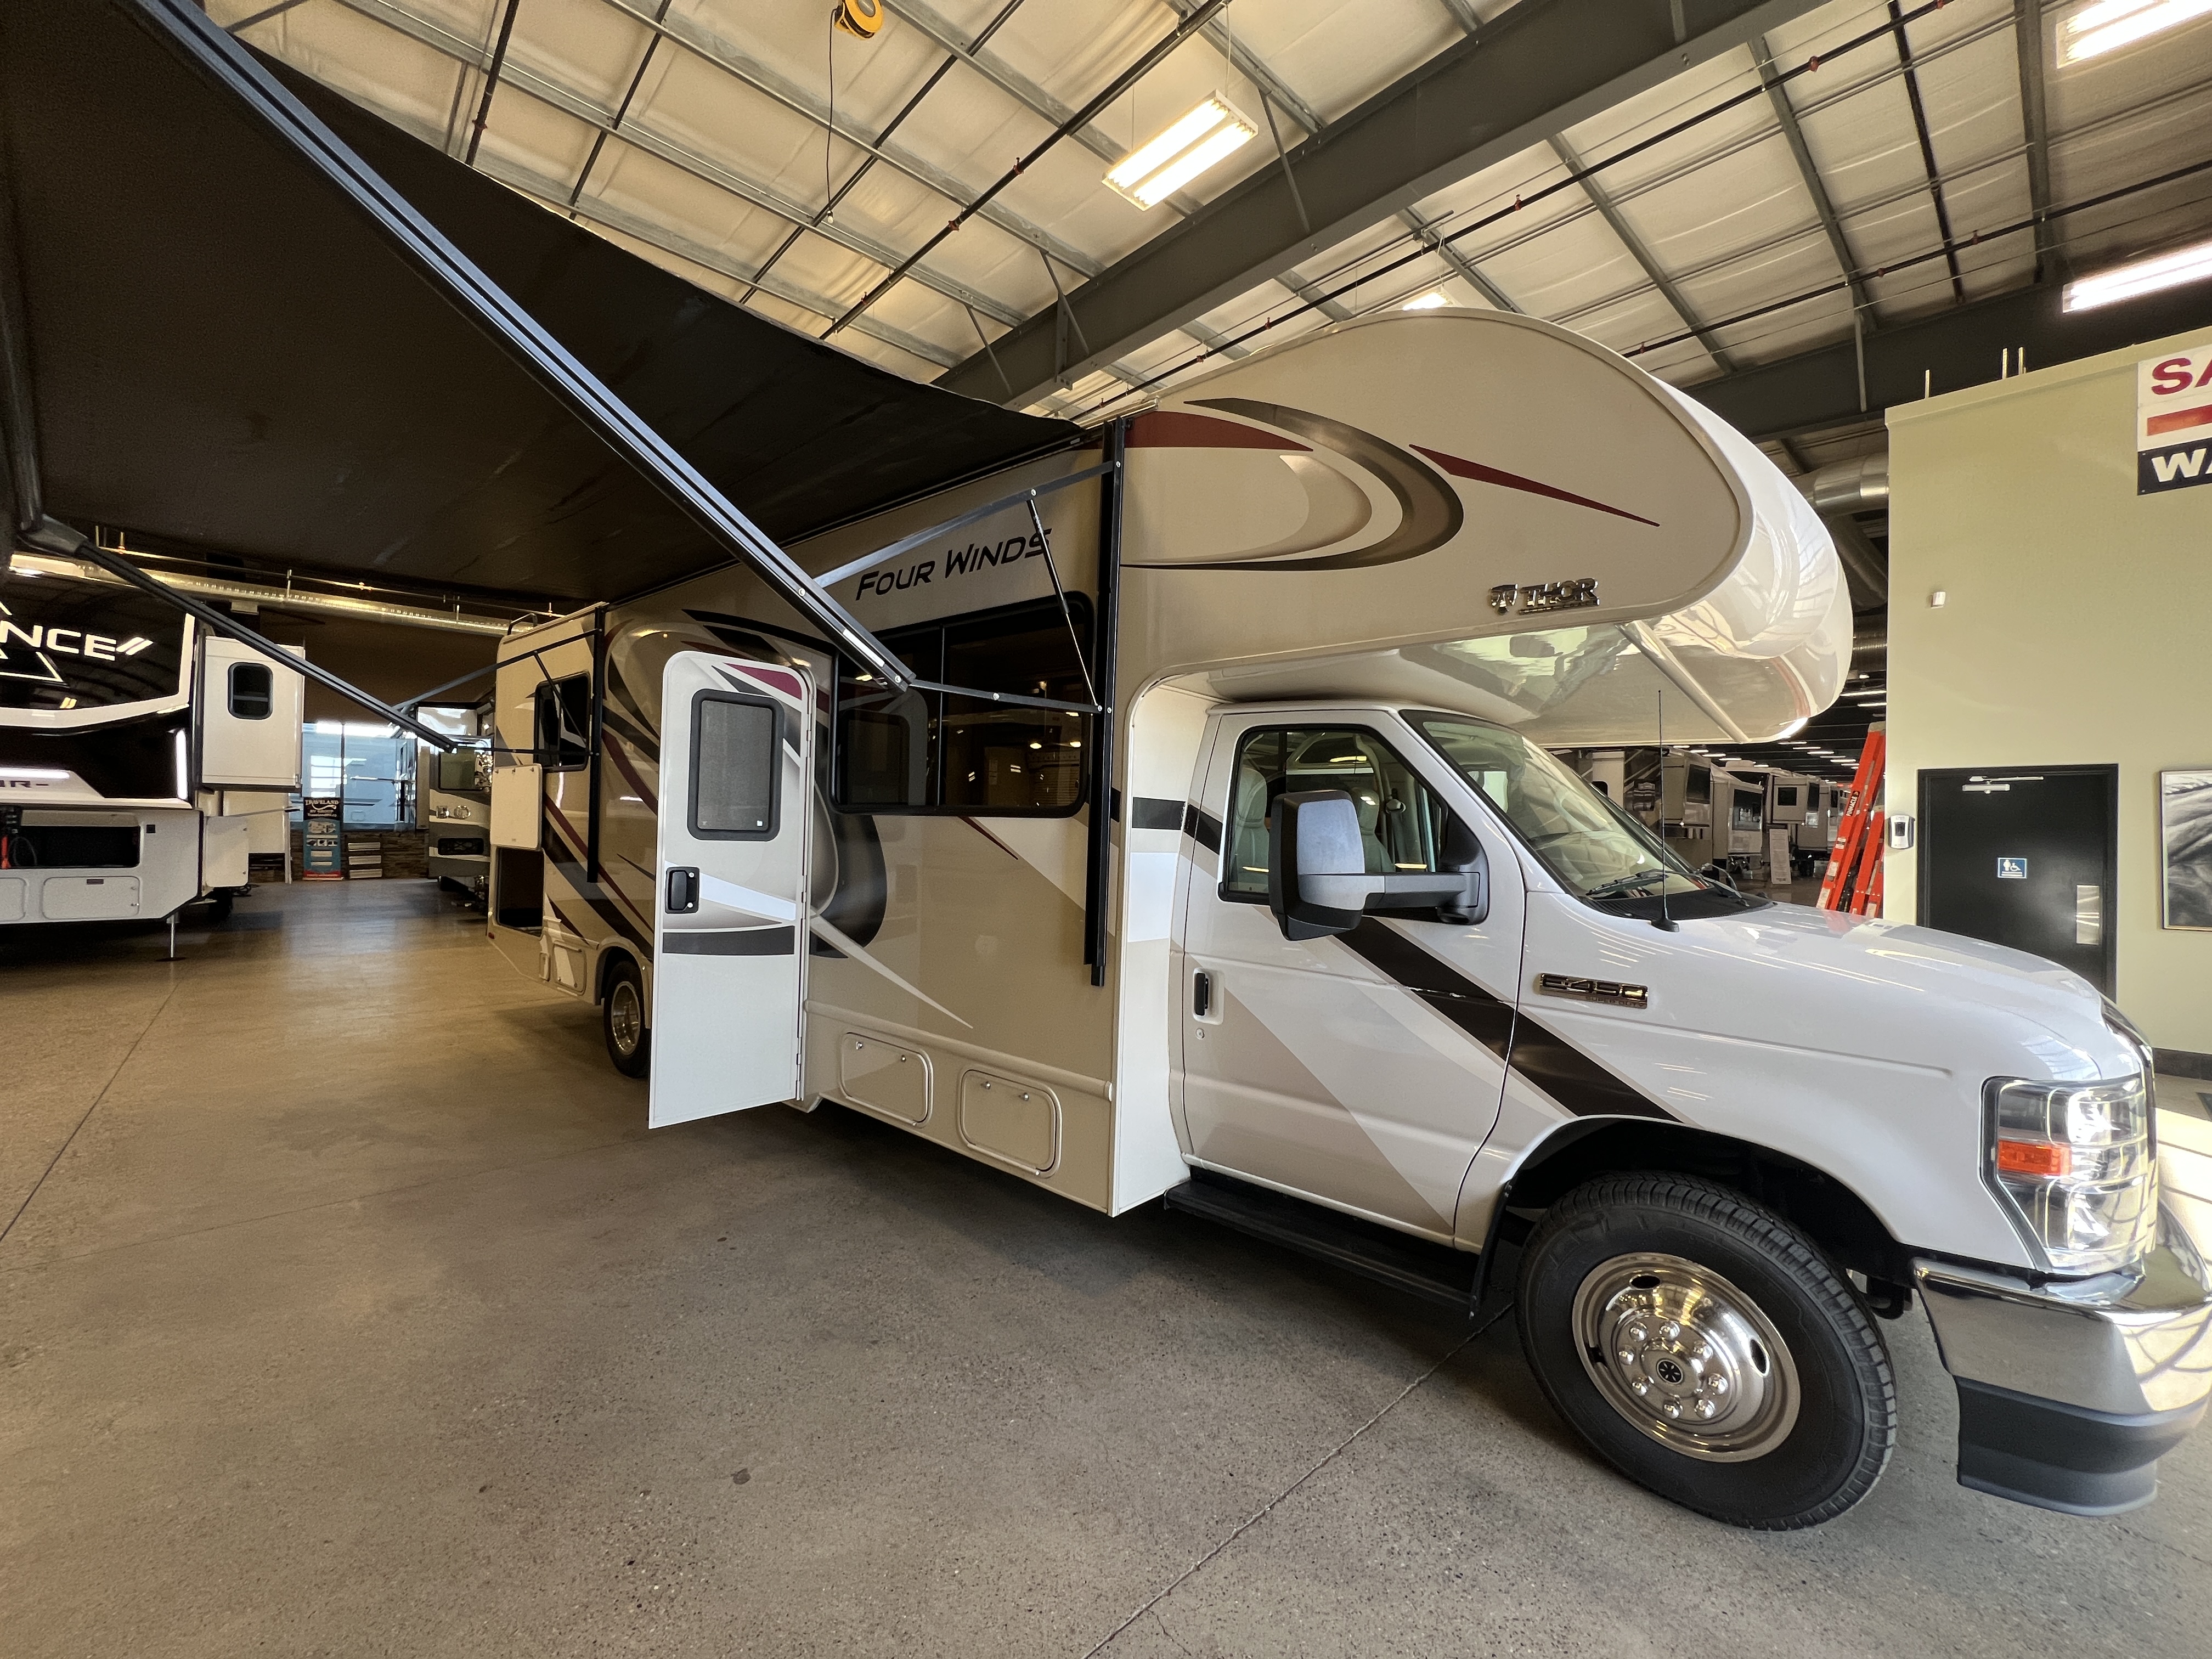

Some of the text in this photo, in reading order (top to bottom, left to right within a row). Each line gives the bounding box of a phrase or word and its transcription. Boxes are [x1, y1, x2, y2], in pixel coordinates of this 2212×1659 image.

[2151, 448, 2212, 482] W
[856, 528, 1053, 601] FOUR WINDS
[1520, 578, 1600, 606] THOR
